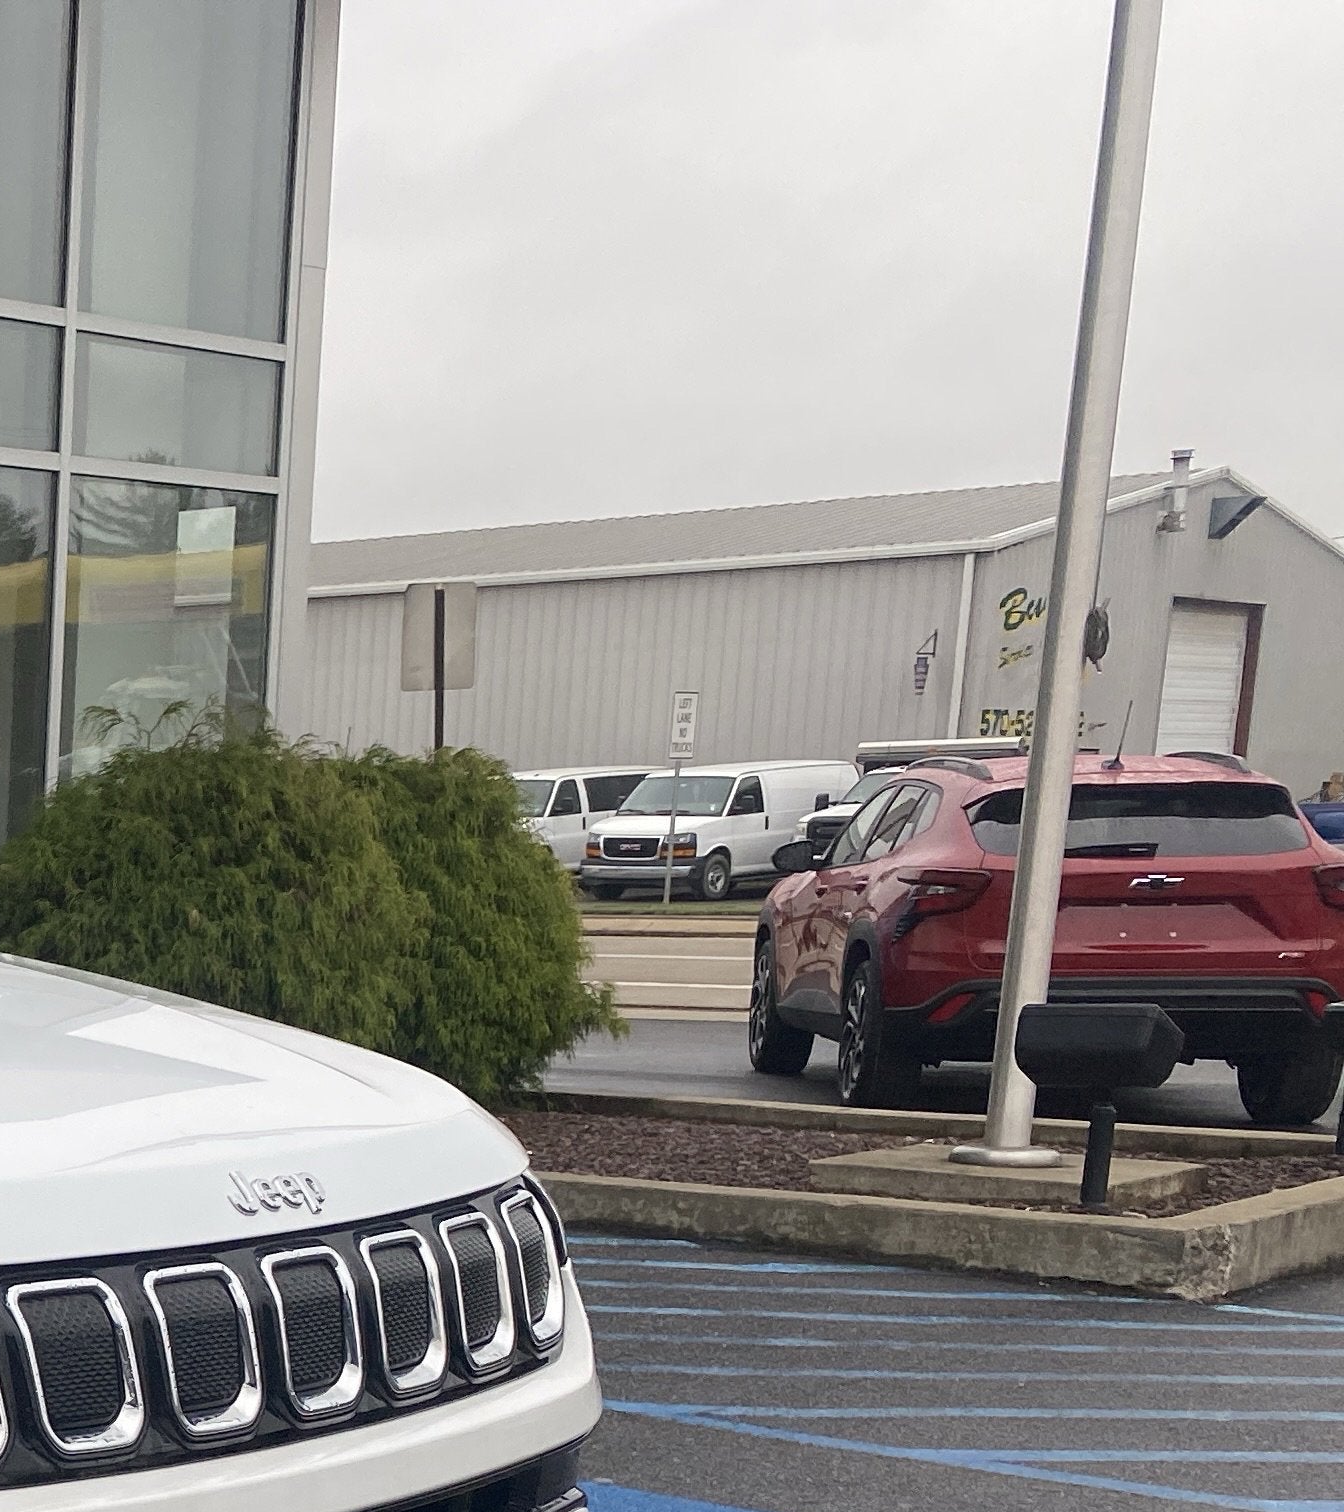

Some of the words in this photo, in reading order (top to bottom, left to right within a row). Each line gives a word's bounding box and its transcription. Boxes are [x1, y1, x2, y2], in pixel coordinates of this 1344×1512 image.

[999, 587, 1048, 631] Bu
[676, 712, 693, 724] LANE
[227, 1170, 326, 1216] Jeep
